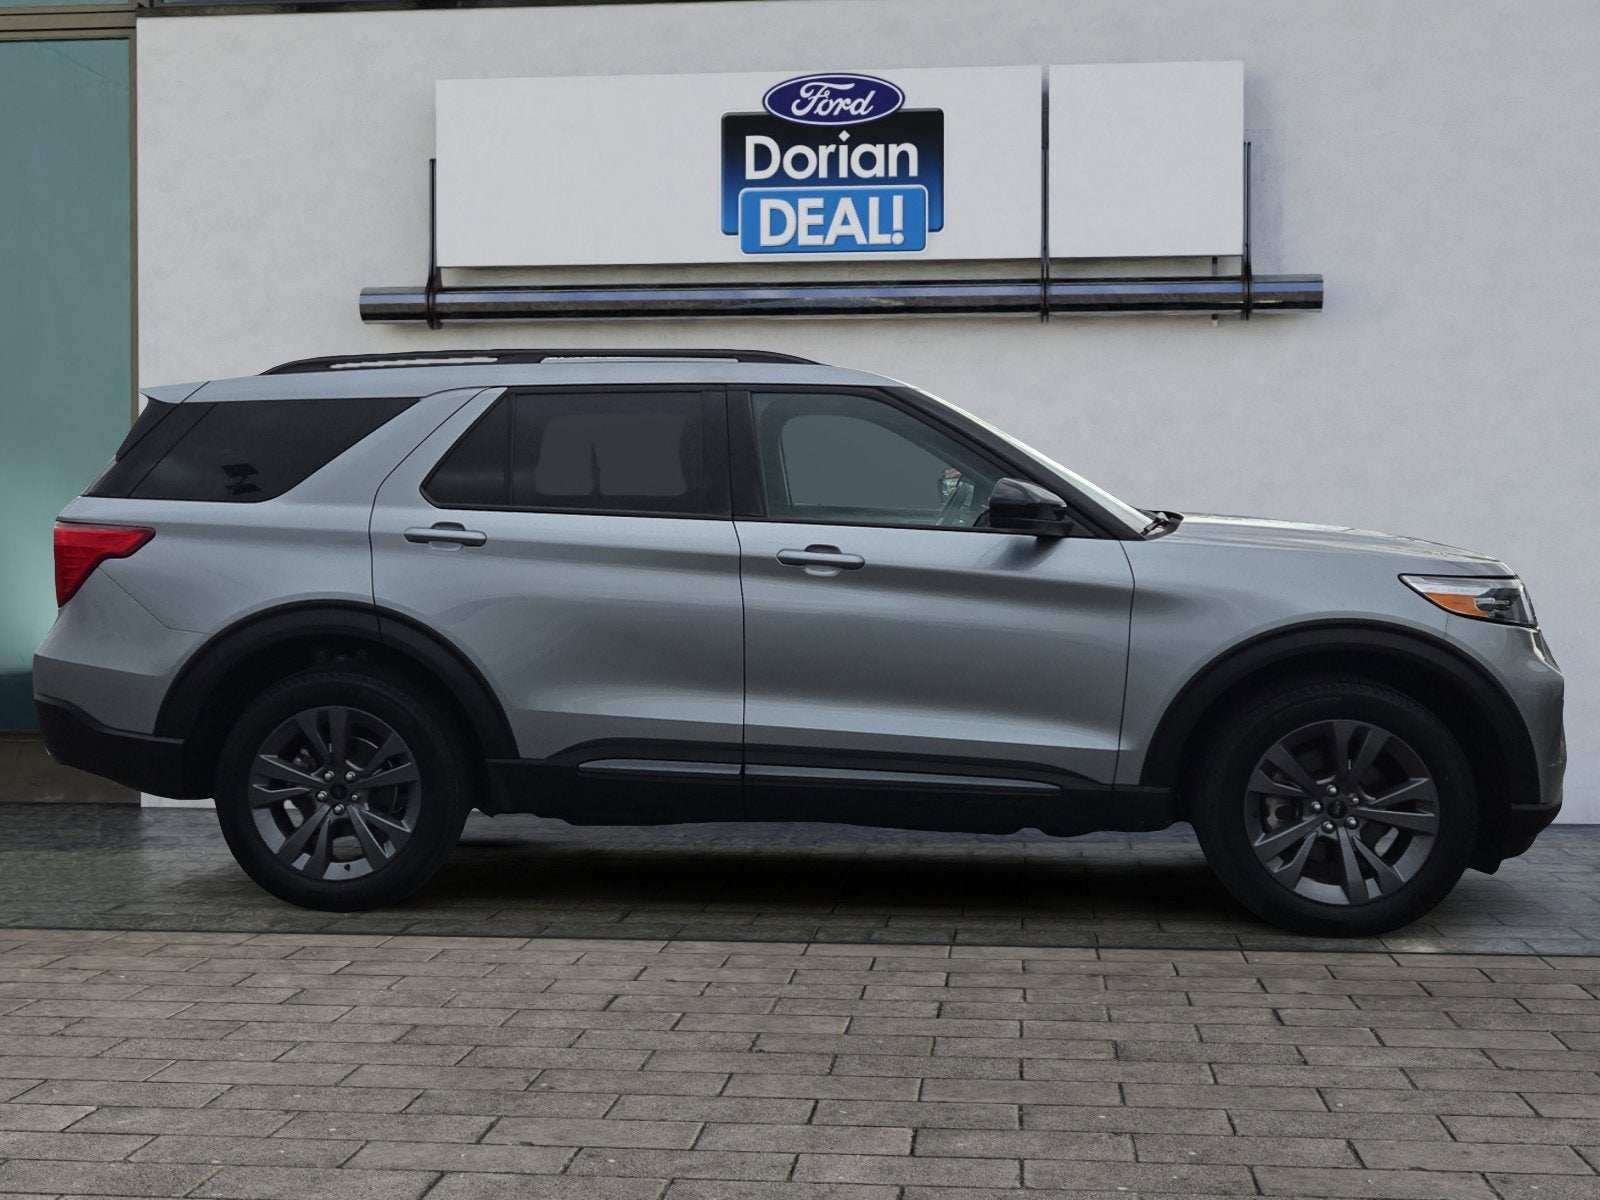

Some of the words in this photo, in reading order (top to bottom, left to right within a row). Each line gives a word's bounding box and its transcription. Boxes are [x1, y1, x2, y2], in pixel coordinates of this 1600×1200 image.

[791, 81, 876, 116] Ford
[745, 130, 919, 180] Dorian
[759, 195, 905, 247] DEAL!
